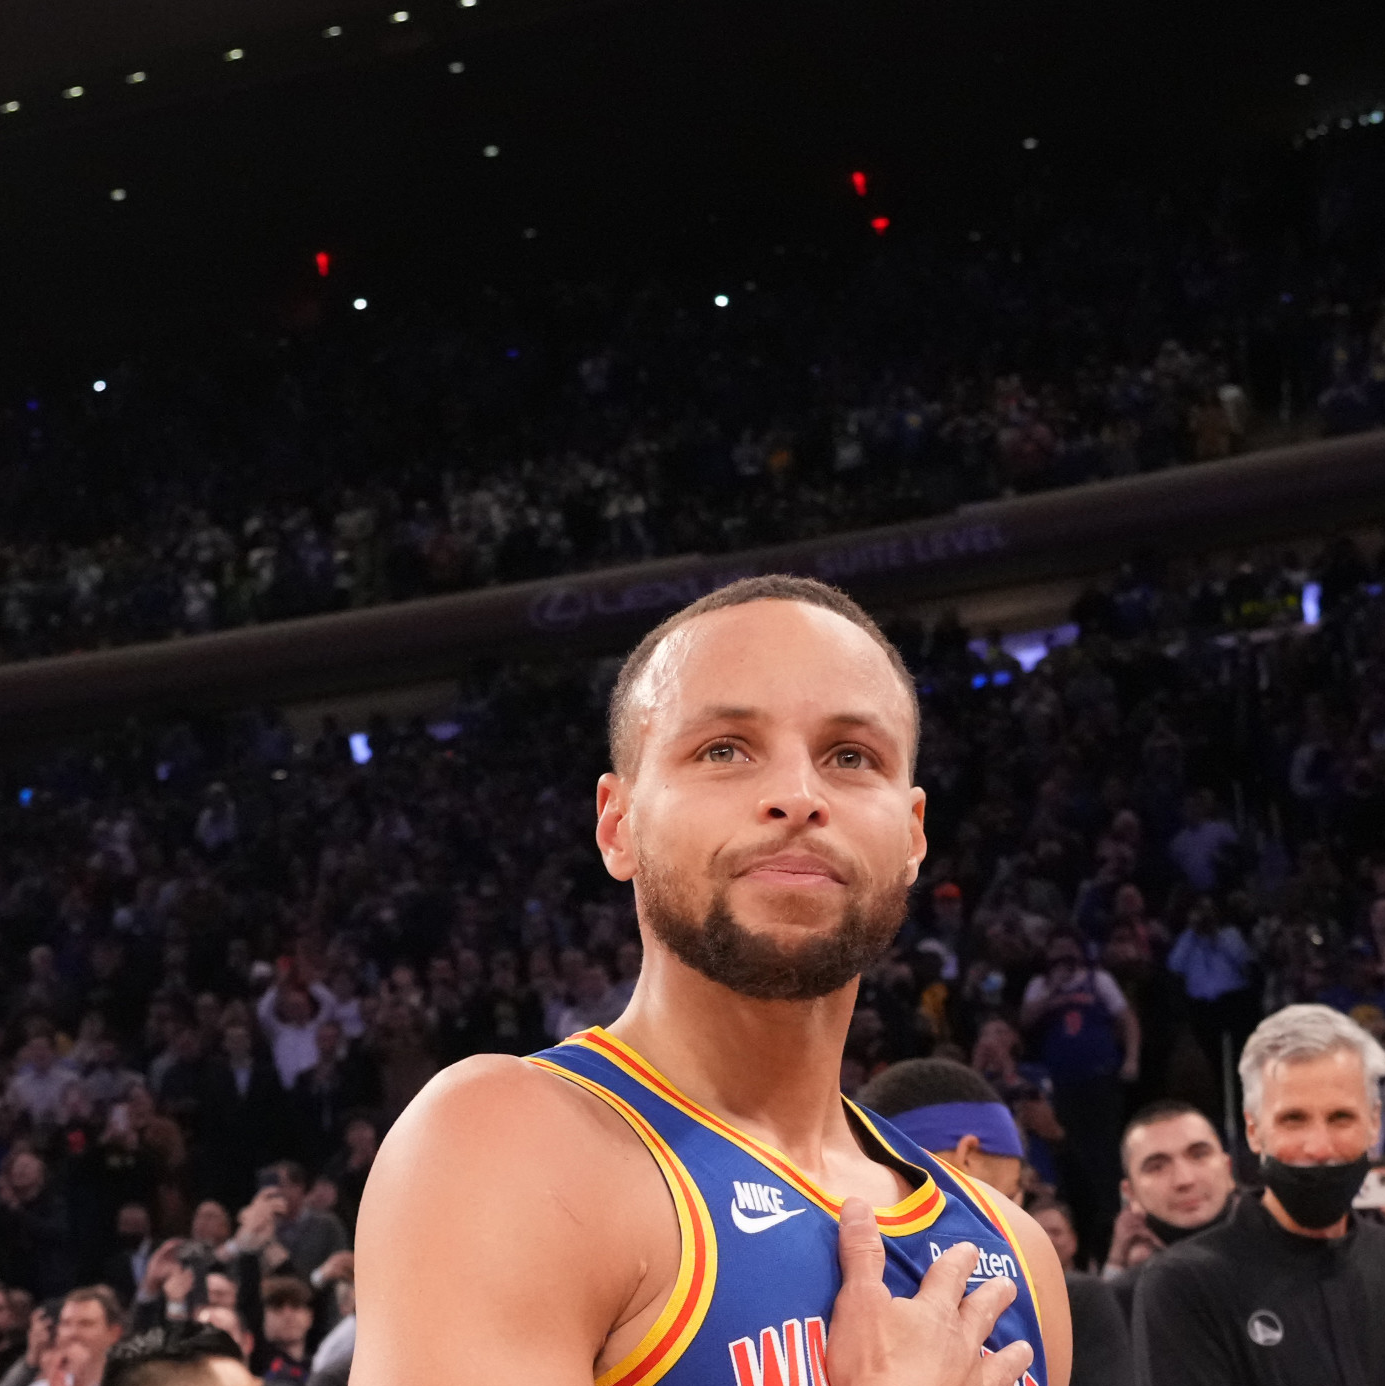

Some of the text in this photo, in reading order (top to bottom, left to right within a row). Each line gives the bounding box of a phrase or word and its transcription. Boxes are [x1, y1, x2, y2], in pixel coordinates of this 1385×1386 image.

[917, 523, 1008, 562] LEVEL
[733, 1181, 785, 1214] NIKE
[930, 1241, 1018, 1277] Rten
